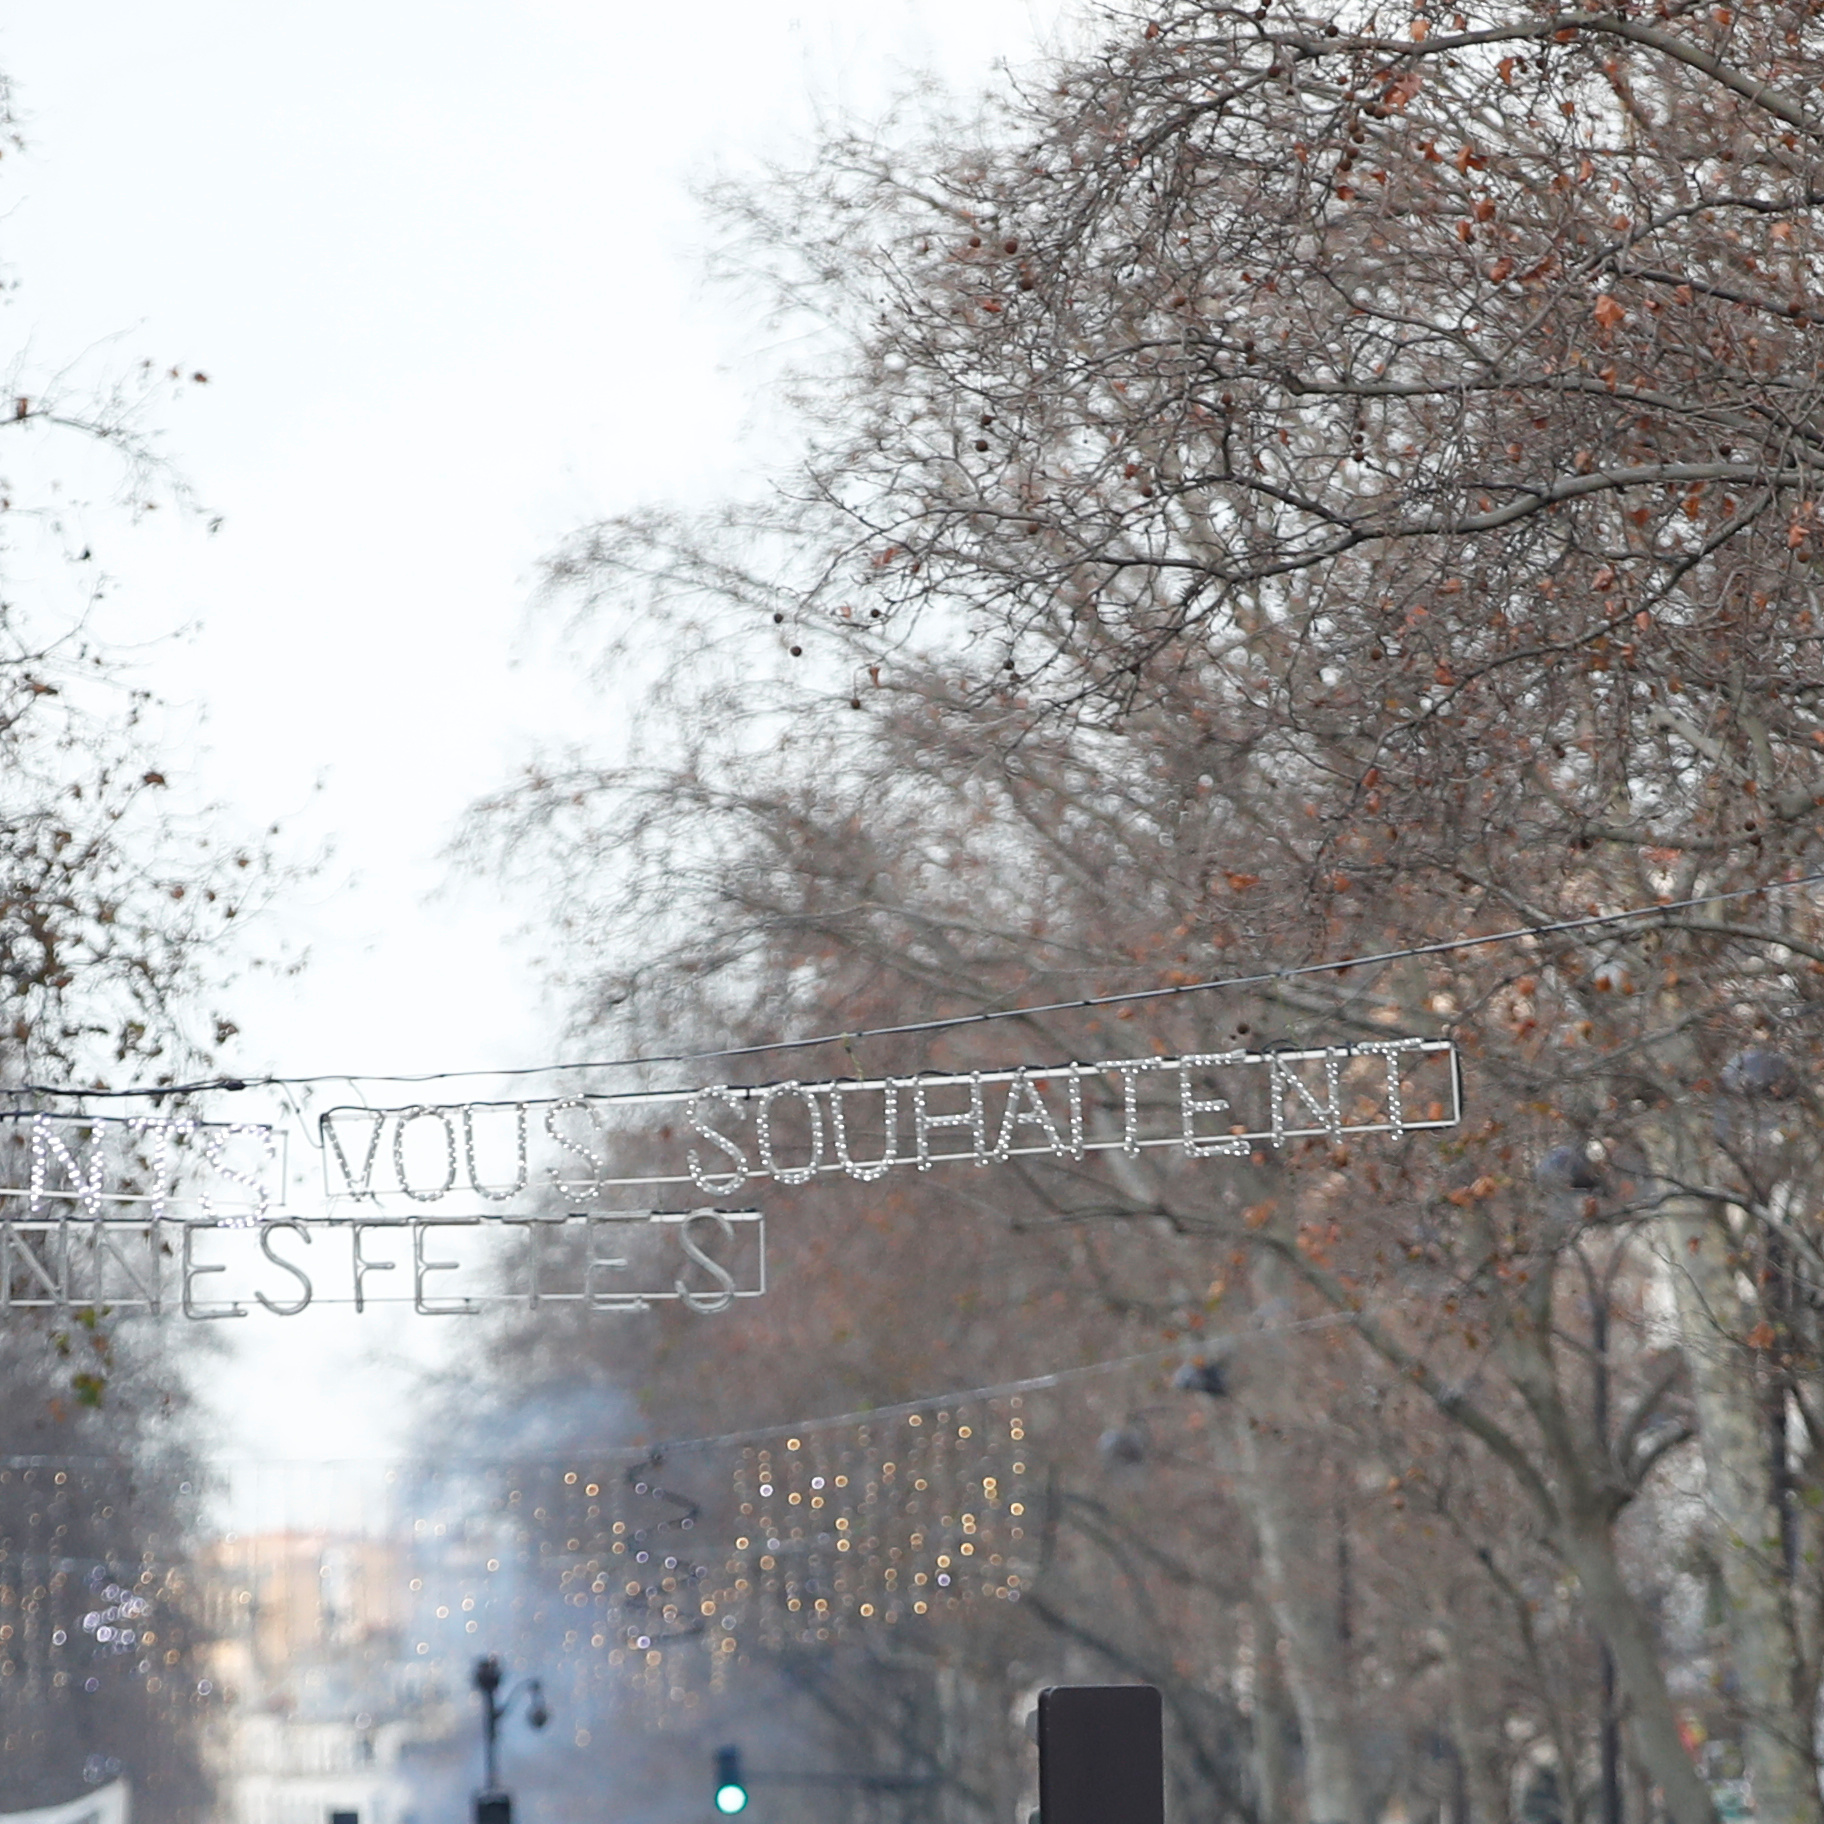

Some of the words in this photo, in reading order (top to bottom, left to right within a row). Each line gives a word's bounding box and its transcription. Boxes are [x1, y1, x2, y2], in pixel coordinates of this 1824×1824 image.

[324, 1094, 604, 1202] VOUS
[686, 1037, 1428, 1196] SOUHAITENT
[351, 1207, 736, 1316] FETES
